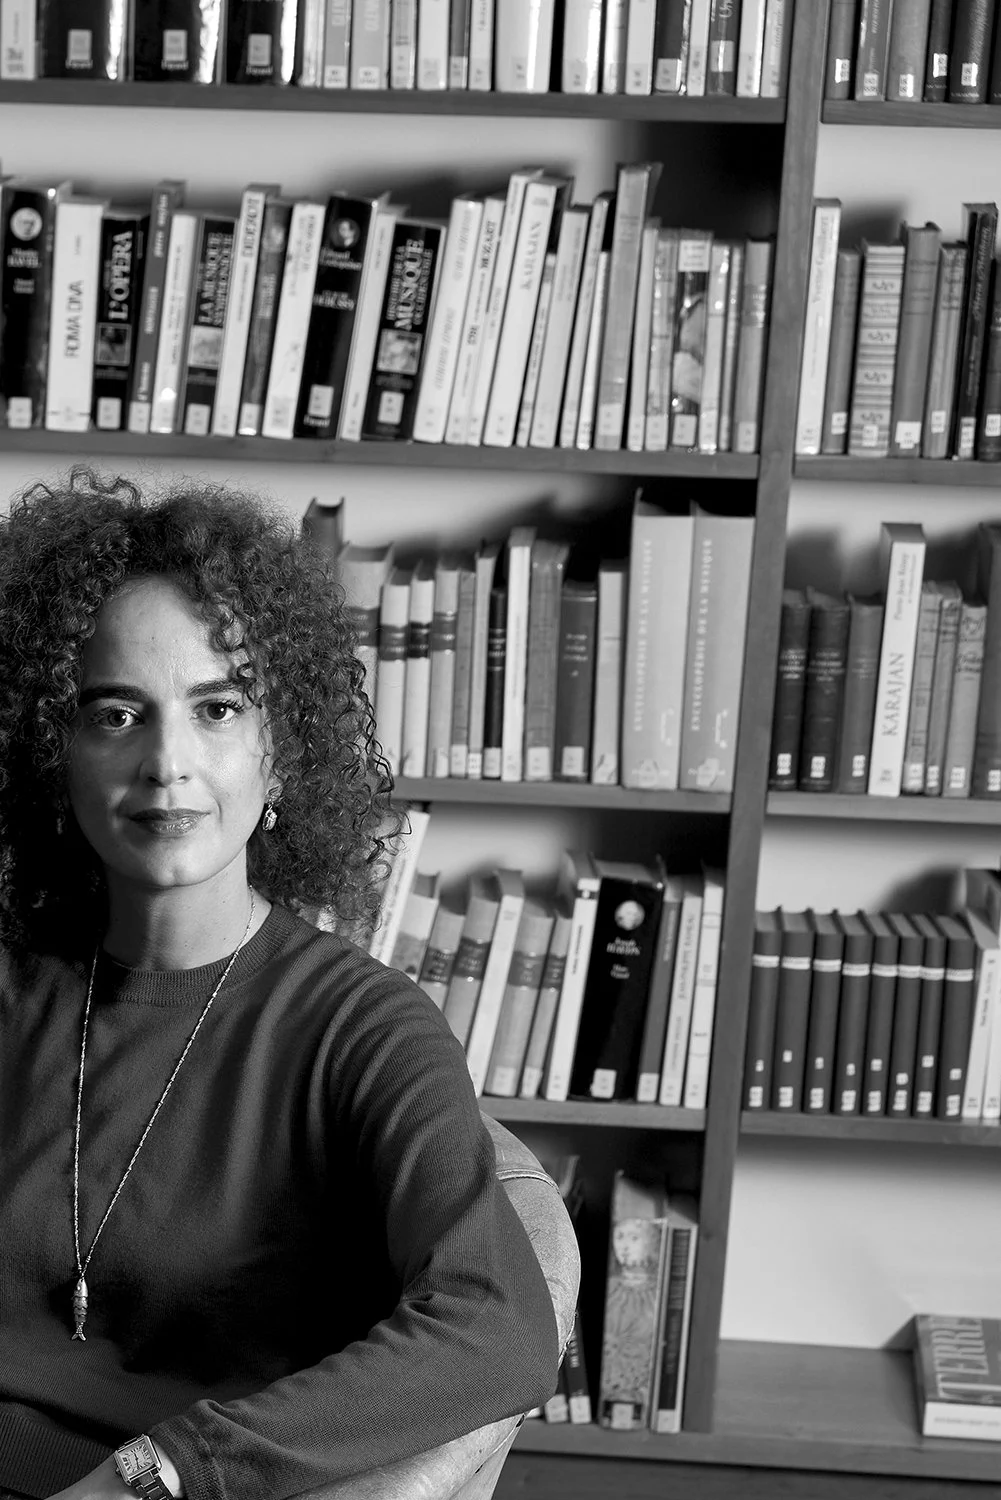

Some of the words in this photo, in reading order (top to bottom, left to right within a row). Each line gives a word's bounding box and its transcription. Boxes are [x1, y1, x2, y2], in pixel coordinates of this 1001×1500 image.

[242, 197, 260, 258] DIDEROT
[394, 239, 425, 332] MUSIQUE
[881, 652, 906, 737] KARAJAN
